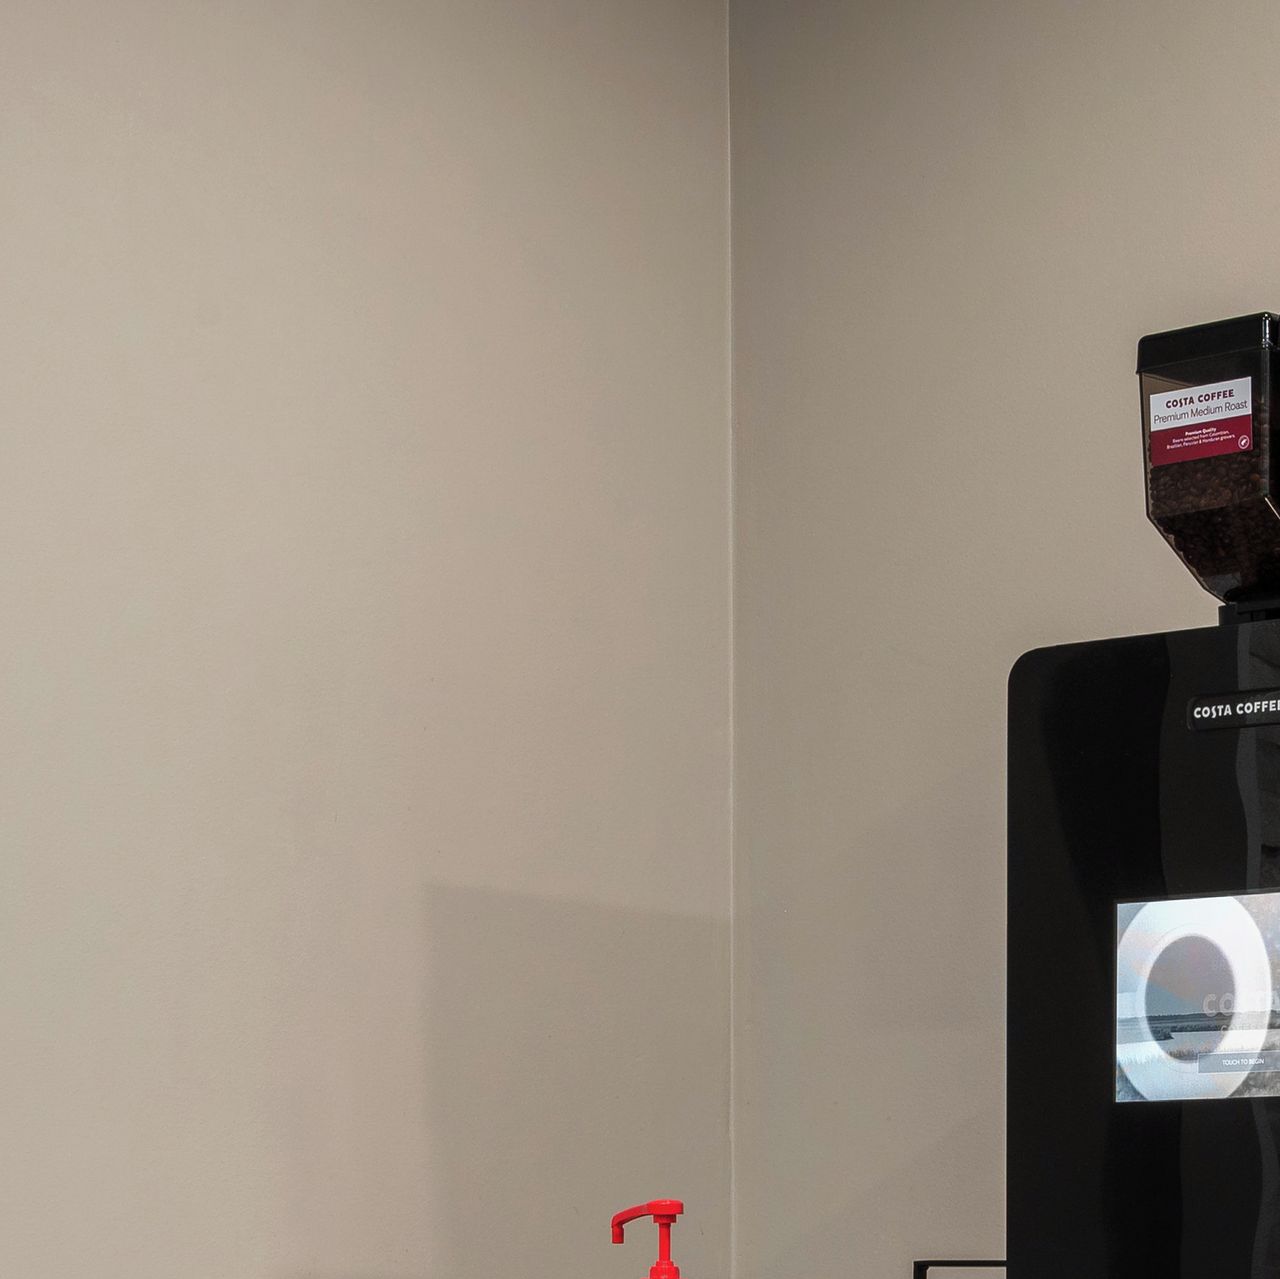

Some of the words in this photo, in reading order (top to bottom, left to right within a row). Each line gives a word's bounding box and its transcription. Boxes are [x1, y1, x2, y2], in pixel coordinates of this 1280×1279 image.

[1166, 396, 1195, 409] COSTA
[1198, 389, 1235, 404] COFFEE
[1154, 411, 1189, 425] Premium
[1190, 405, 1223, 418] Medium
[1224, 400, 1248, 414] Roast
[1193, 704, 1232, 719] COSTA
[1222, 1058, 1241, 1066] TOUCH
[1241, 1058, 1248, 1066] TO
[1249, 1058, 1265, 1066] BEGIN
